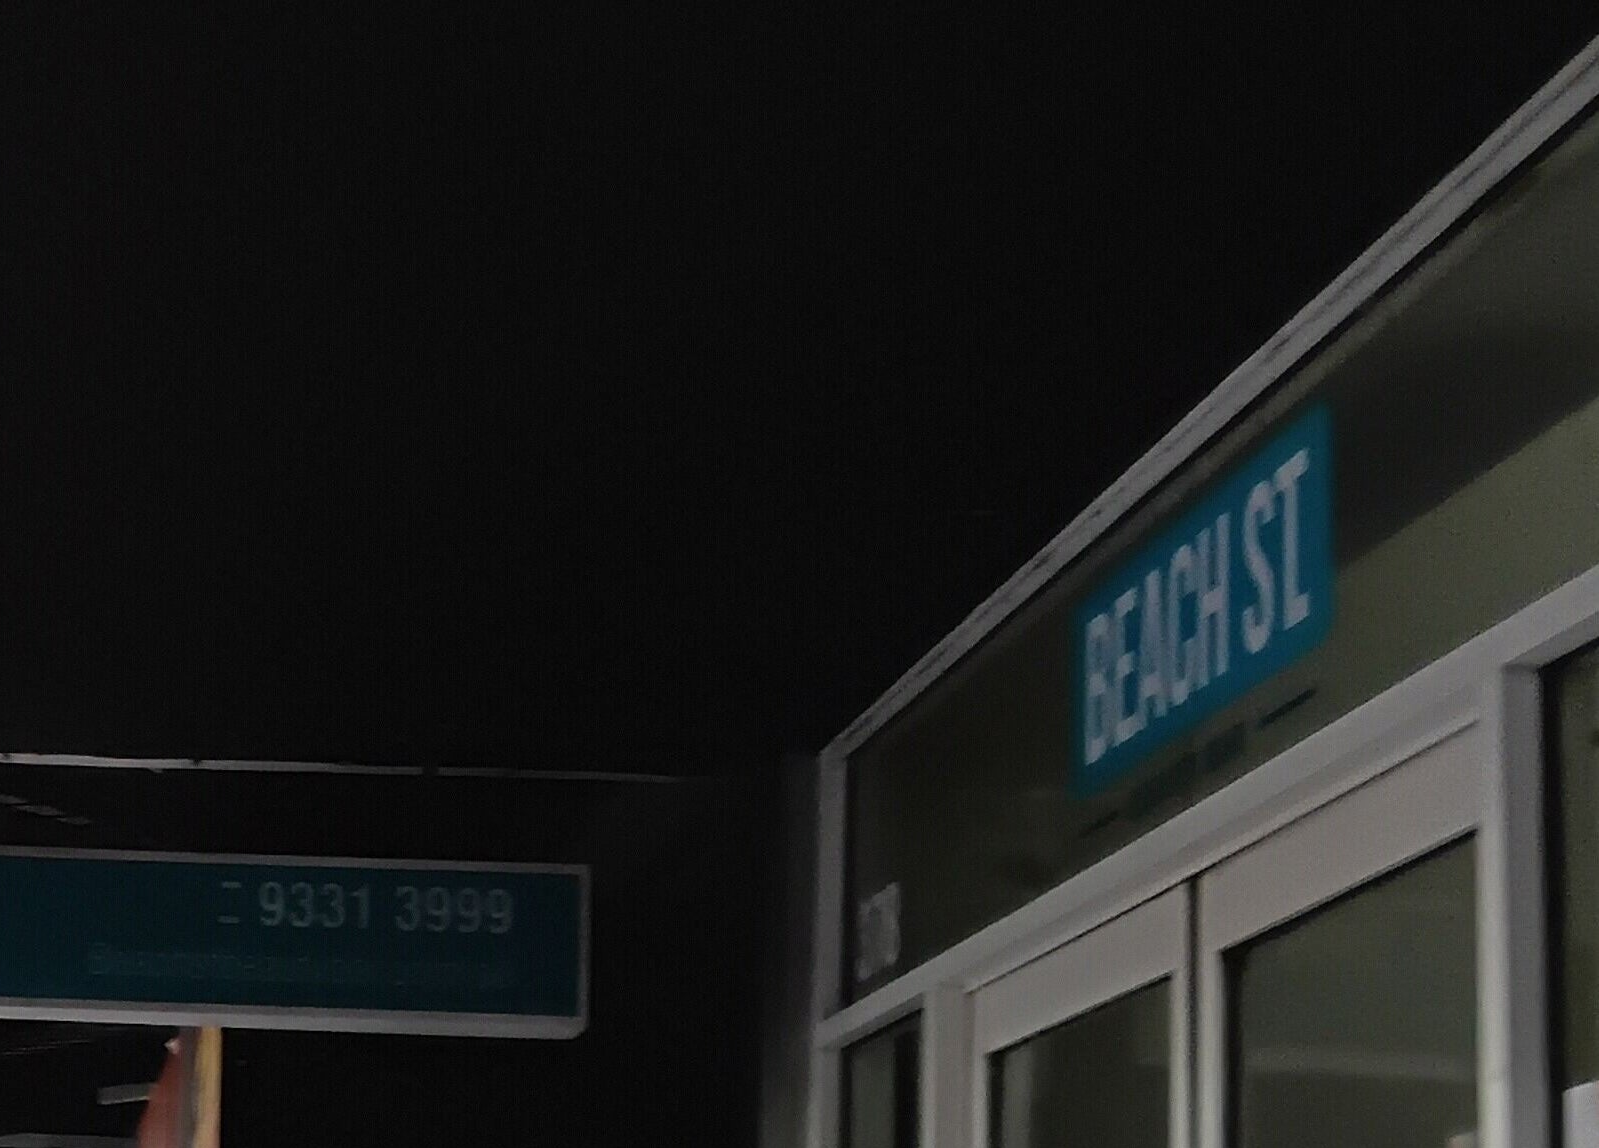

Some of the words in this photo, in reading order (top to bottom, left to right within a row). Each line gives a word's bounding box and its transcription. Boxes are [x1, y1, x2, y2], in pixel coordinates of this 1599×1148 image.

[1083, 513, 1232, 766] BEACH
[258, 881, 371, 930] 9331
[393, 885, 514, 935] 3999
